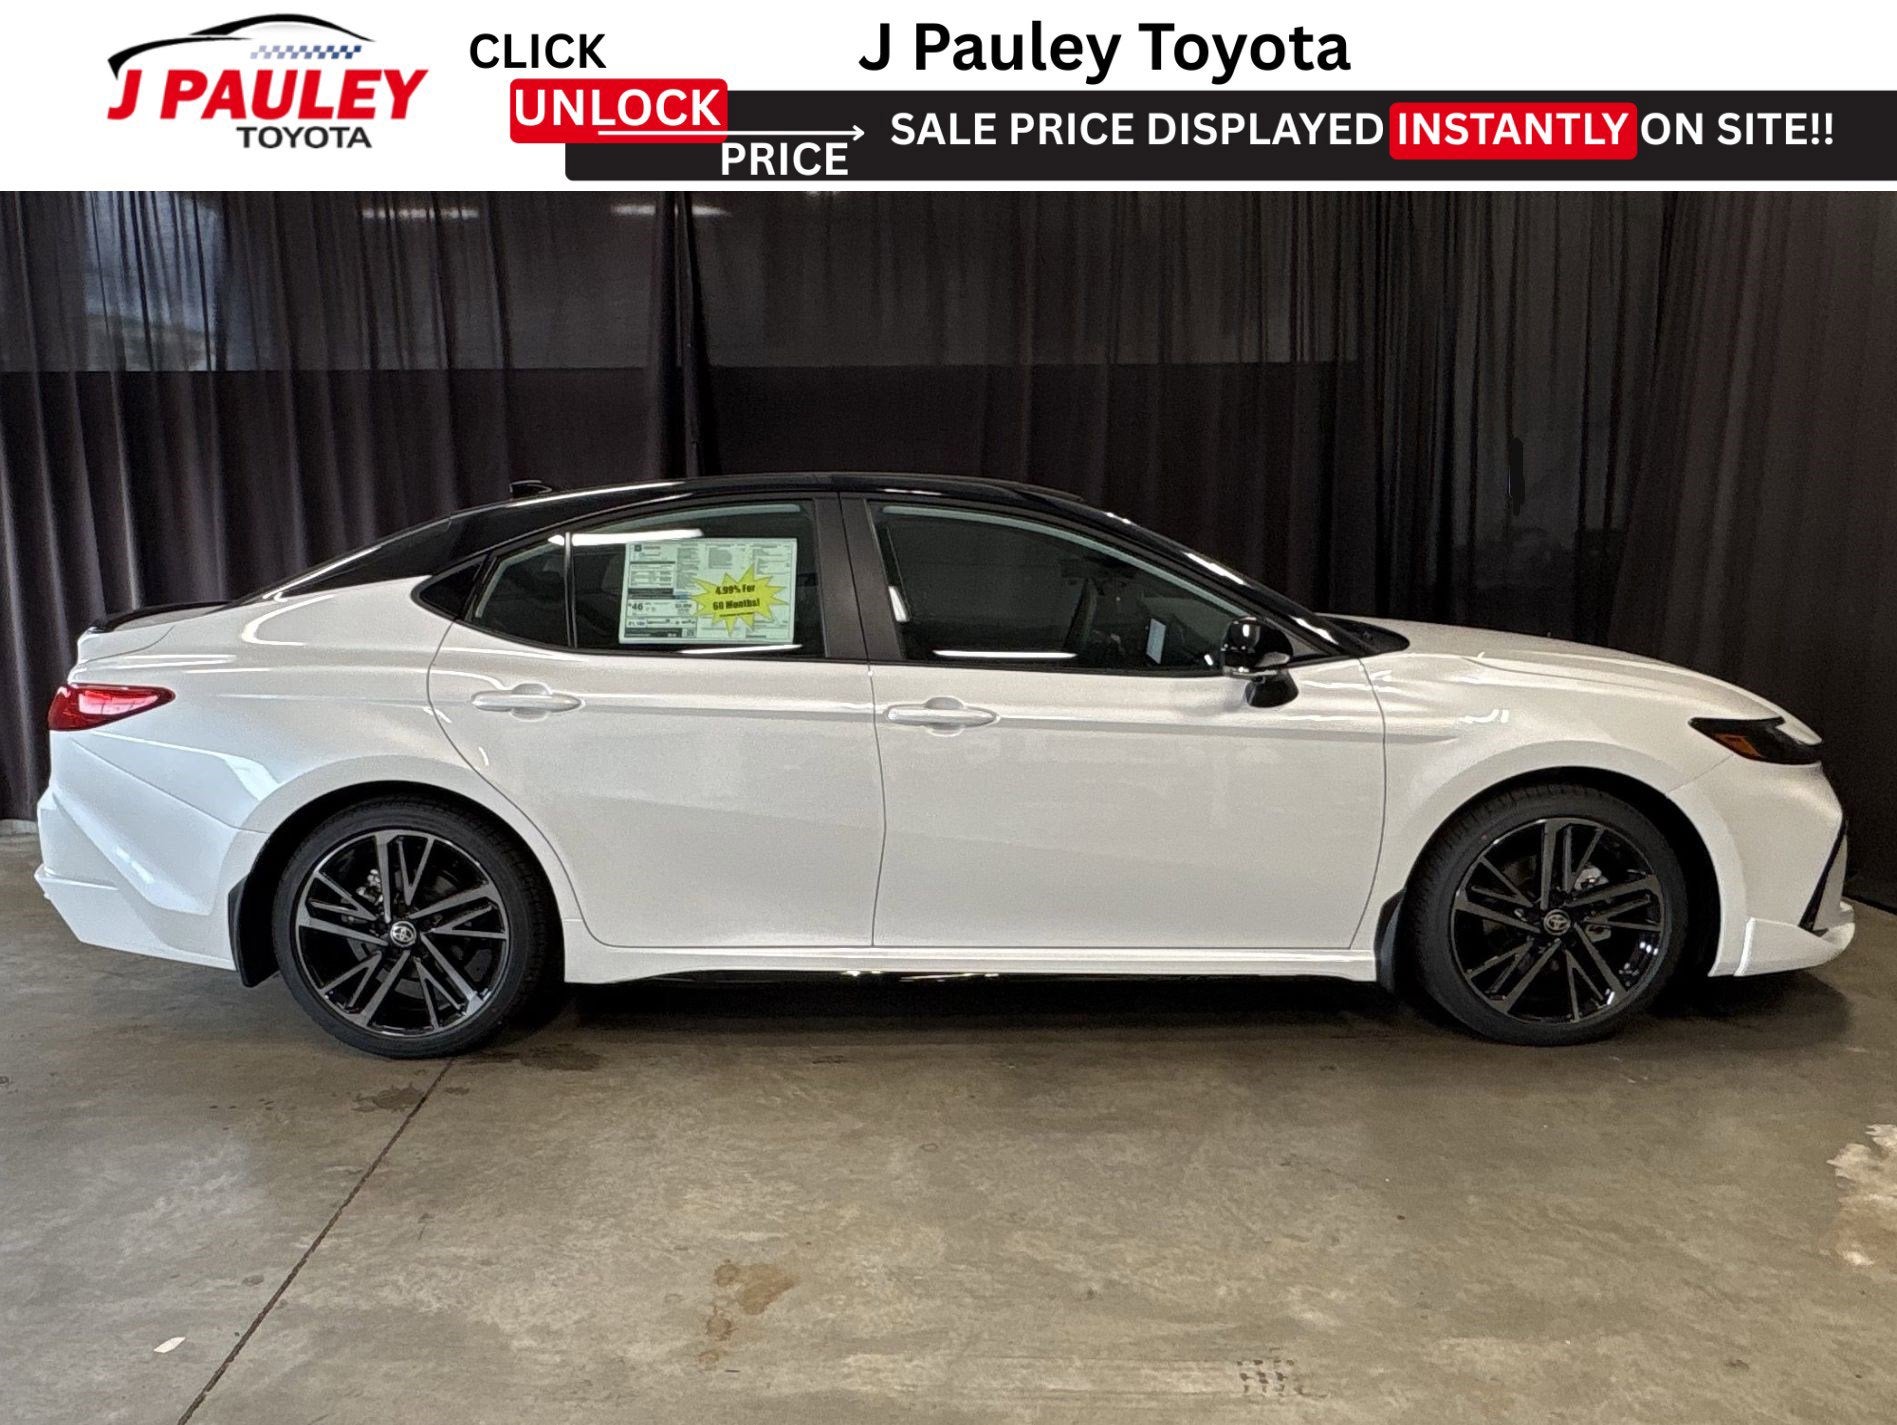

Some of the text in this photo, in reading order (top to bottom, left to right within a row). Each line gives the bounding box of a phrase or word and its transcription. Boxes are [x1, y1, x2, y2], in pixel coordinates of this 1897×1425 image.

[715, 585, 741, 595] 4.99%
[713, 598, 760, 610] 60 Months!
